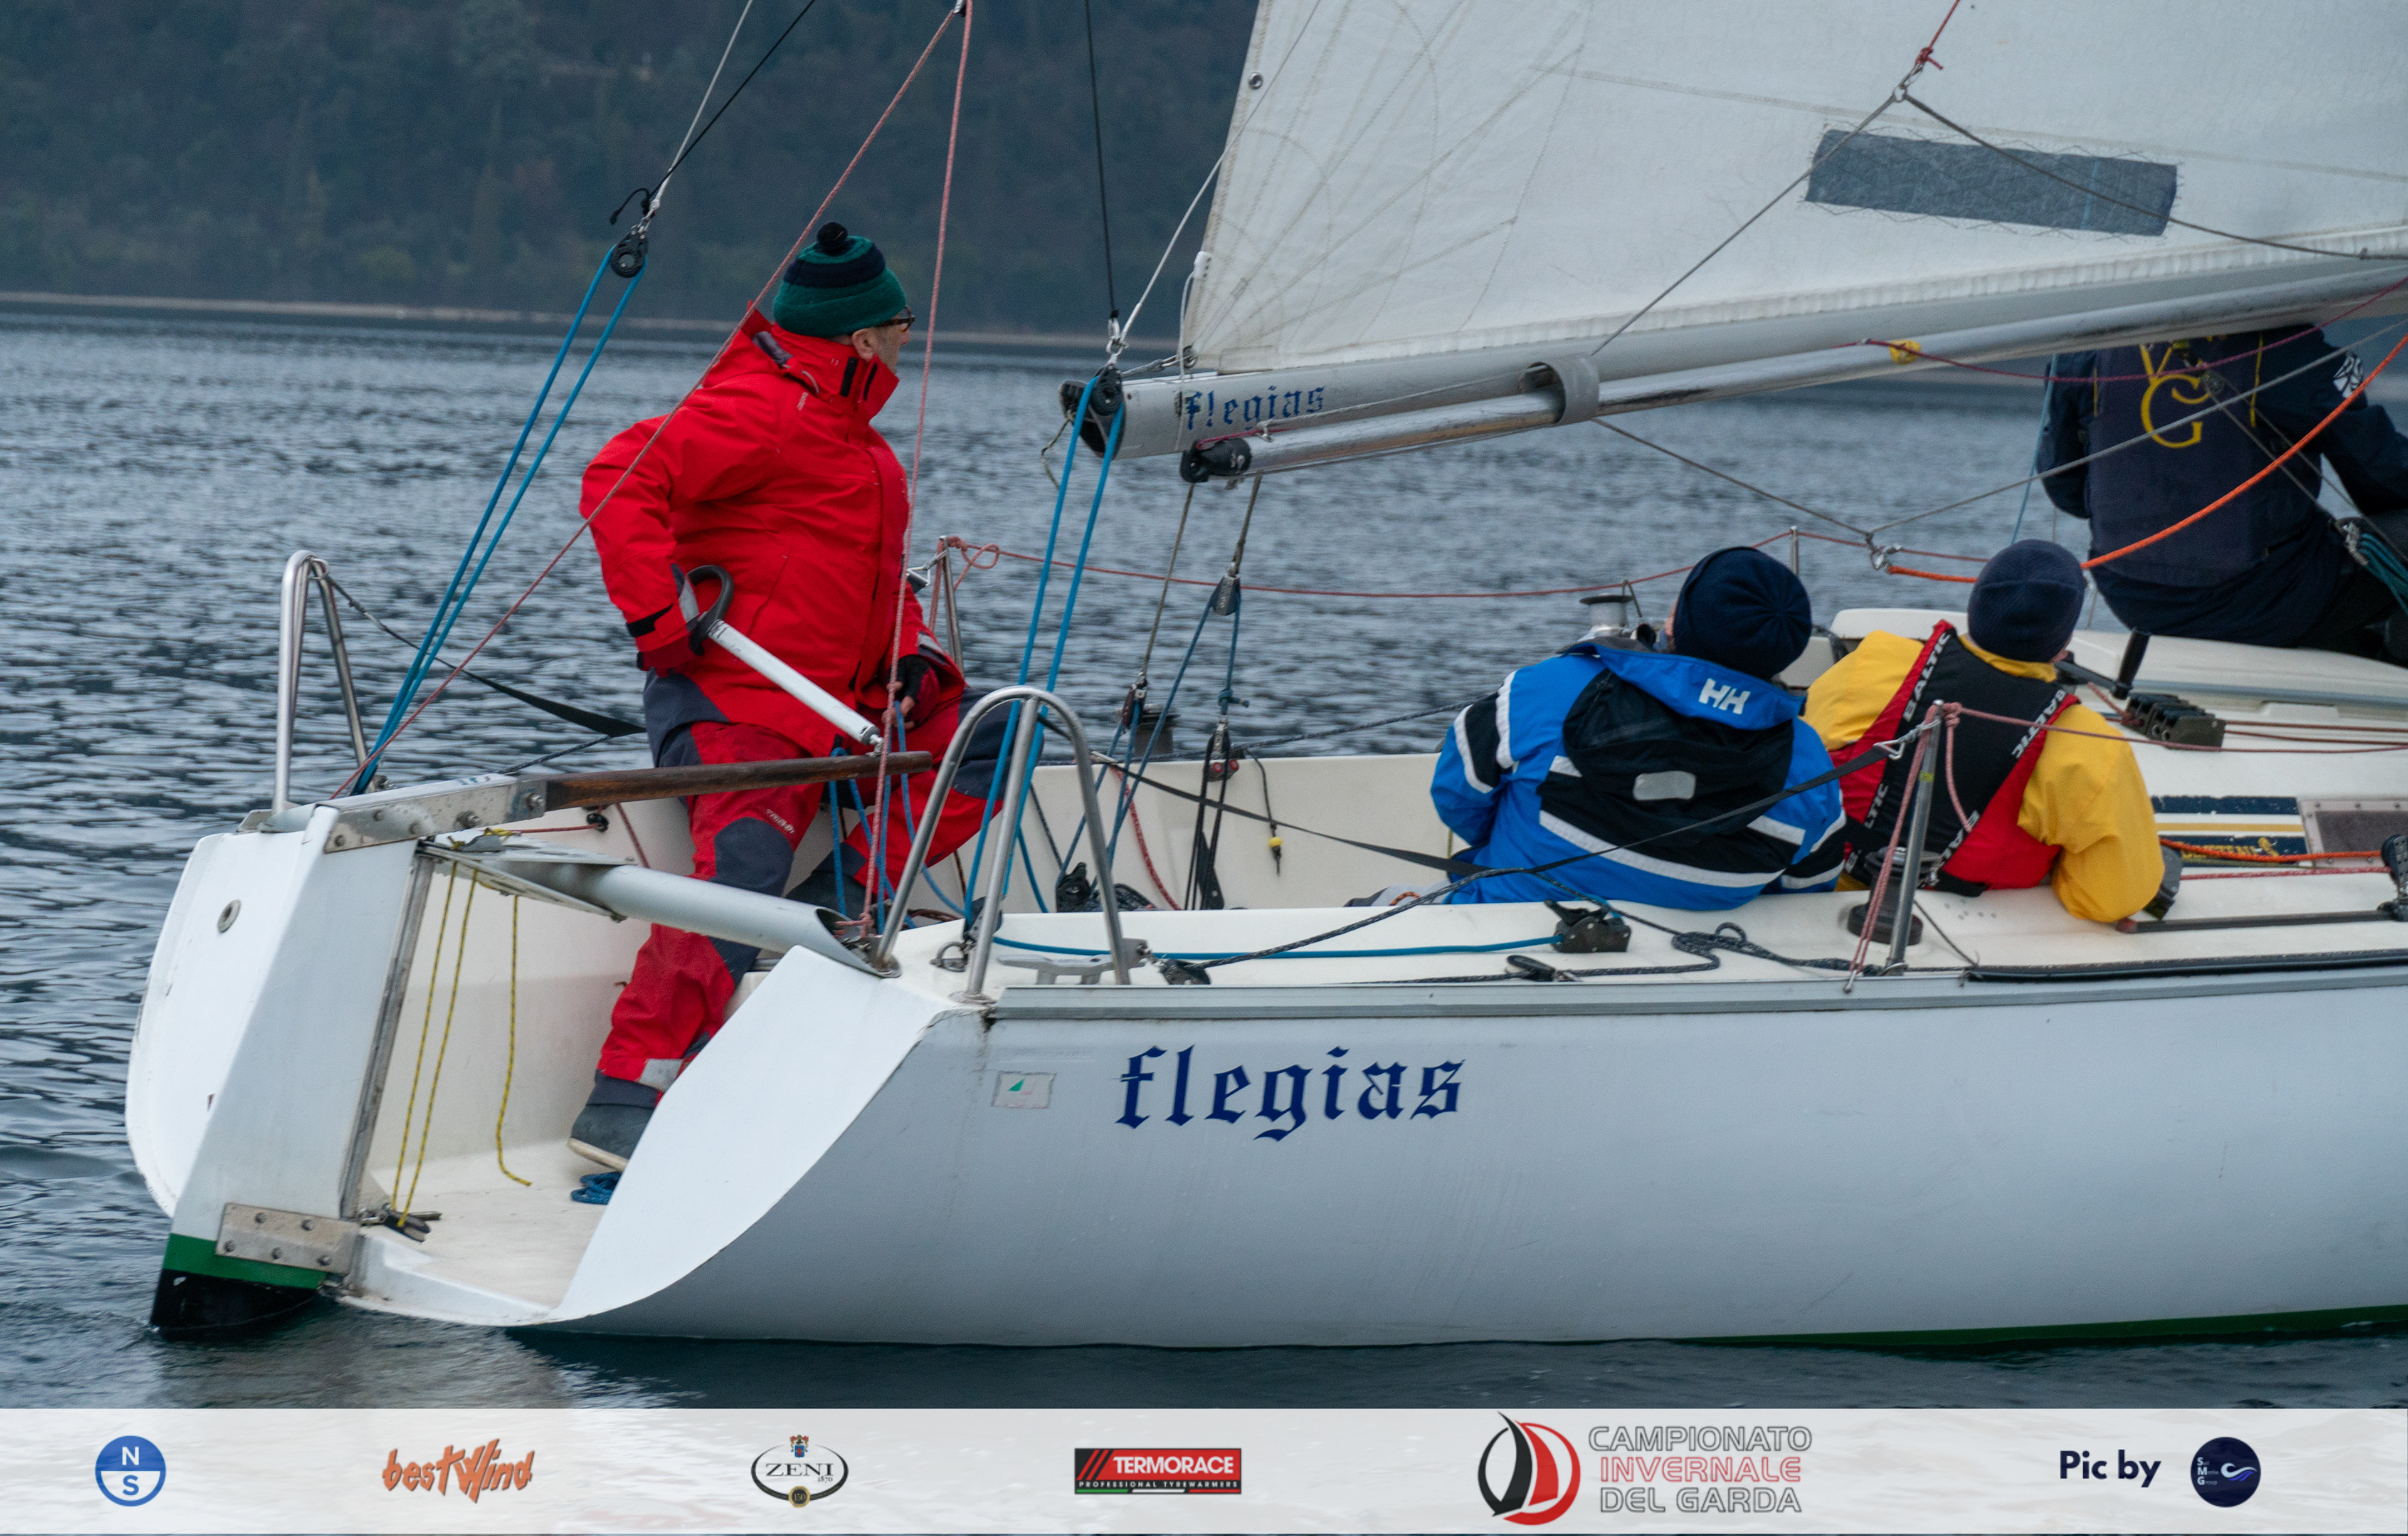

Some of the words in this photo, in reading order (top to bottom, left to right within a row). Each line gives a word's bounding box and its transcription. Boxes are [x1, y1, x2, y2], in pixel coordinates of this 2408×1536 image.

[1188, 386, 1326, 431] flegias
[1698, 678, 1751, 715] HH
[1903, 632, 1952, 722] BALTIC
[2010, 689, 2067, 759] BALTIC
[1115, 1044, 1465, 1142] flegias
